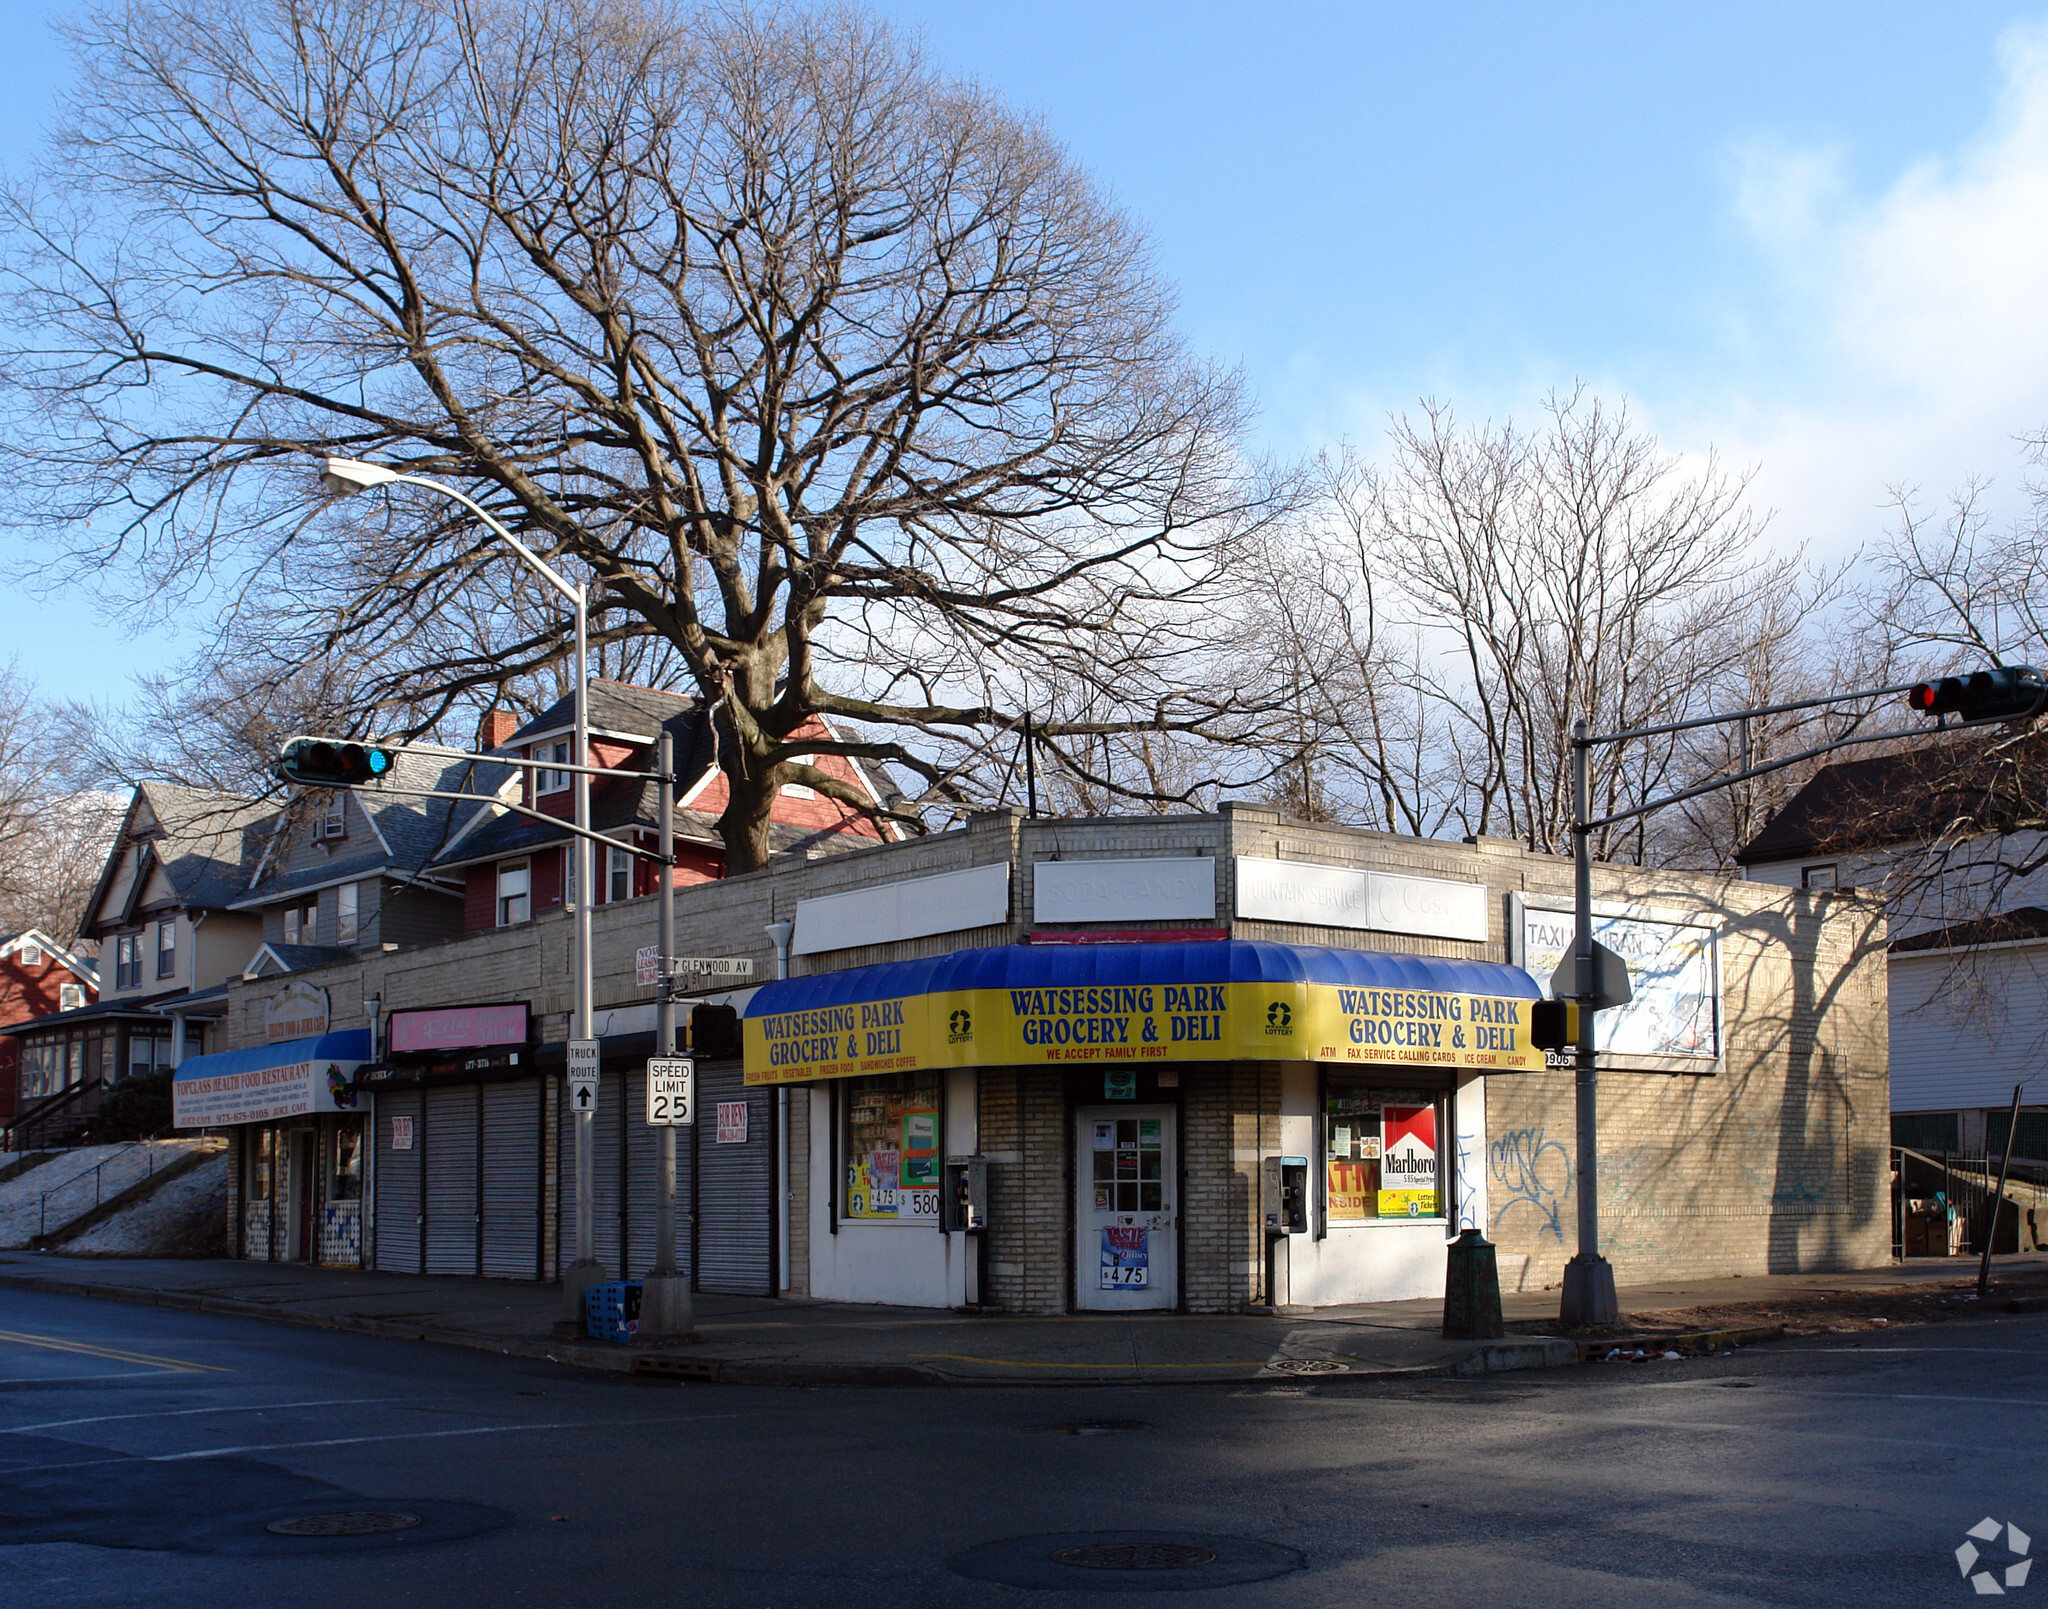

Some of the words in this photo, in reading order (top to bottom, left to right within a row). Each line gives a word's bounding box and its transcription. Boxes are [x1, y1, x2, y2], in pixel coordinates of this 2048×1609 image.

[1311, 884, 1360, 910] SERVICE
[1528, 924, 1564, 947] TAXI
[682, 959, 729, 973] GLENWOOD
[736, 961, 748, 973] AV
[692, 972, 701, 985] ST
[1010, 987, 1154, 1016] WATSESSING
[1163, 985, 1226, 1012] PARK
[1337, 989, 1462, 1021] WATSESSING
[1469, 998, 1519, 1025] PARK
[762, 1006, 854, 1041] WATSESSING
[861, 1000, 904, 1028] PARK
[475, 1025, 515, 1043] SALON
[1022, 1017, 1130, 1045] GROCERY
[1141, 1016, 1159, 1042] &
[1171, 1015, 1221, 1041] DELI
[1265, 1028, 1293, 1036] LOTTERY
[1349, 1018, 1442, 1048] GROCERY
[1452, 1024, 1467, 1049] &
[1476, 1026, 1515, 1051] DELI
[769, 1035, 839, 1066] GROCERY
[846, 1034, 858, 1058] &
[866, 1028, 901, 1056] DELI
[948, 1036, 973, 1045] LOTTERY
[570, 1048, 597, 1059] TRUCK
[1047, 1049, 1061, 1060] WE
[1064, 1048, 1101, 1060] ACCEPT
[1105, 1047, 1136, 1058] FAMILY
[1141, 1046, 1168, 1058] FIRST
[1320, 1046, 1336, 1058] ATM
[1347, 1048, 1362, 1059] FAX
[1364, 1048, 1396, 1060] SERVICE
[1398, 1050, 1430, 1062] CALLING
[1432, 1051, 1456, 1063] CARDS
[1464, 1053, 1475, 1063] ICE
[1476, 1054, 1497, 1065] CREAM
[1507, 1056, 1526, 1067] CANDY
[570, 1066, 596, 1077] ROUTE
[652, 1065, 689, 1078] SPEED
[745, 1072, 760, 1082] FRESH
[761, 1070, 778, 1080] FRUITS
[782, 1067, 812, 1079] VEGETABLES
[819, 1063, 839, 1075] FROZEN
[840, 1062, 853, 1073] FOOD
[860, 1059, 894, 1071] SANDWICHES
[896, 1056, 916, 1068] COFFEE
[177, 1081, 212, 1096] TOPCLASS
[213, 1075, 240, 1092] HEALTH
[241, 1072, 260, 1089] FOOD
[262, 1063, 311, 1085] RESTAURANT
[655, 1081, 686, 1093] LIMIT
[216, 1109, 269, 1123] 973-675-0105
[273, 1105, 289, 1117] JUICE
[291, 1102, 307, 1113] CAFE
[654, 1096, 687, 1119] 25
[719, 1104, 731, 1127] FOR
[731, 1103, 745, 1127] RENT
[1385, 1149, 1435, 1174] Marlboro
[901, 1195, 906, 1205] $
[1328, 1196, 1371, 1208] NSIDE
[1417, 1194, 1436, 1203] Lottery
[1420, 1201, 1438, 1209] Tickets
[1105, 1227, 1146, 1242] TASTE
[1111, 1267, 1142, 1283] 4.75
